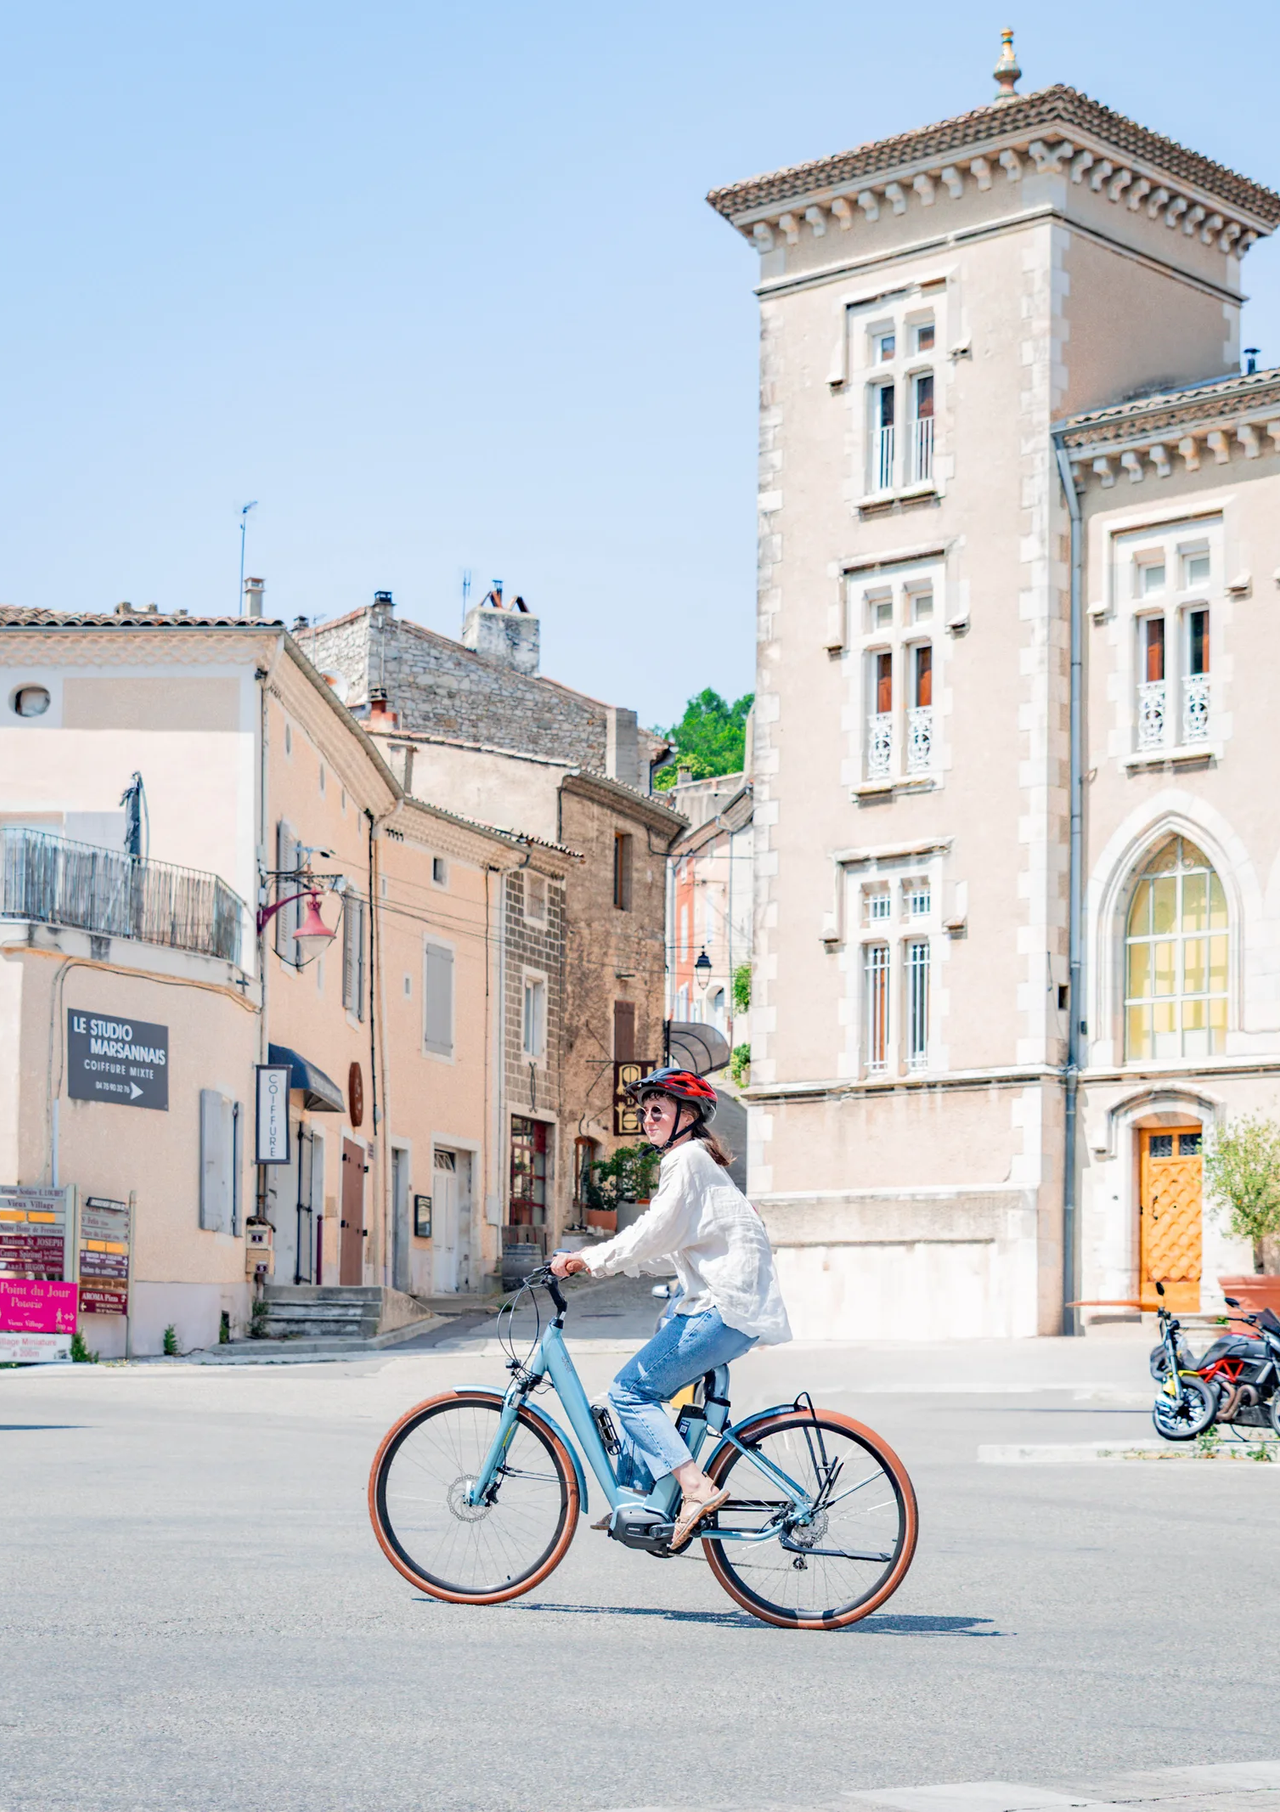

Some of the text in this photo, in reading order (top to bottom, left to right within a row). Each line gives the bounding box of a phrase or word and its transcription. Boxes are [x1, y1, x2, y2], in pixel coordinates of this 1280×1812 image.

[73, 1016, 133, 1041] LE STUDIO
[90, 1038, 166, 1065] MARSANNAIS
[83, 1059, 154, 1079] COIFFURE MIXTE
[268, 1074, 278, 1157] COIFFURE
[7, 1199, 54, 1210] Vieux Village
[2, 1237, 25, 1245] Maison
[37, 1239, 63, 1247] JOSEPH
[0, 1282, 71, 1298] Point du Jour
[11, 1297, 43, 1308] Poterie
